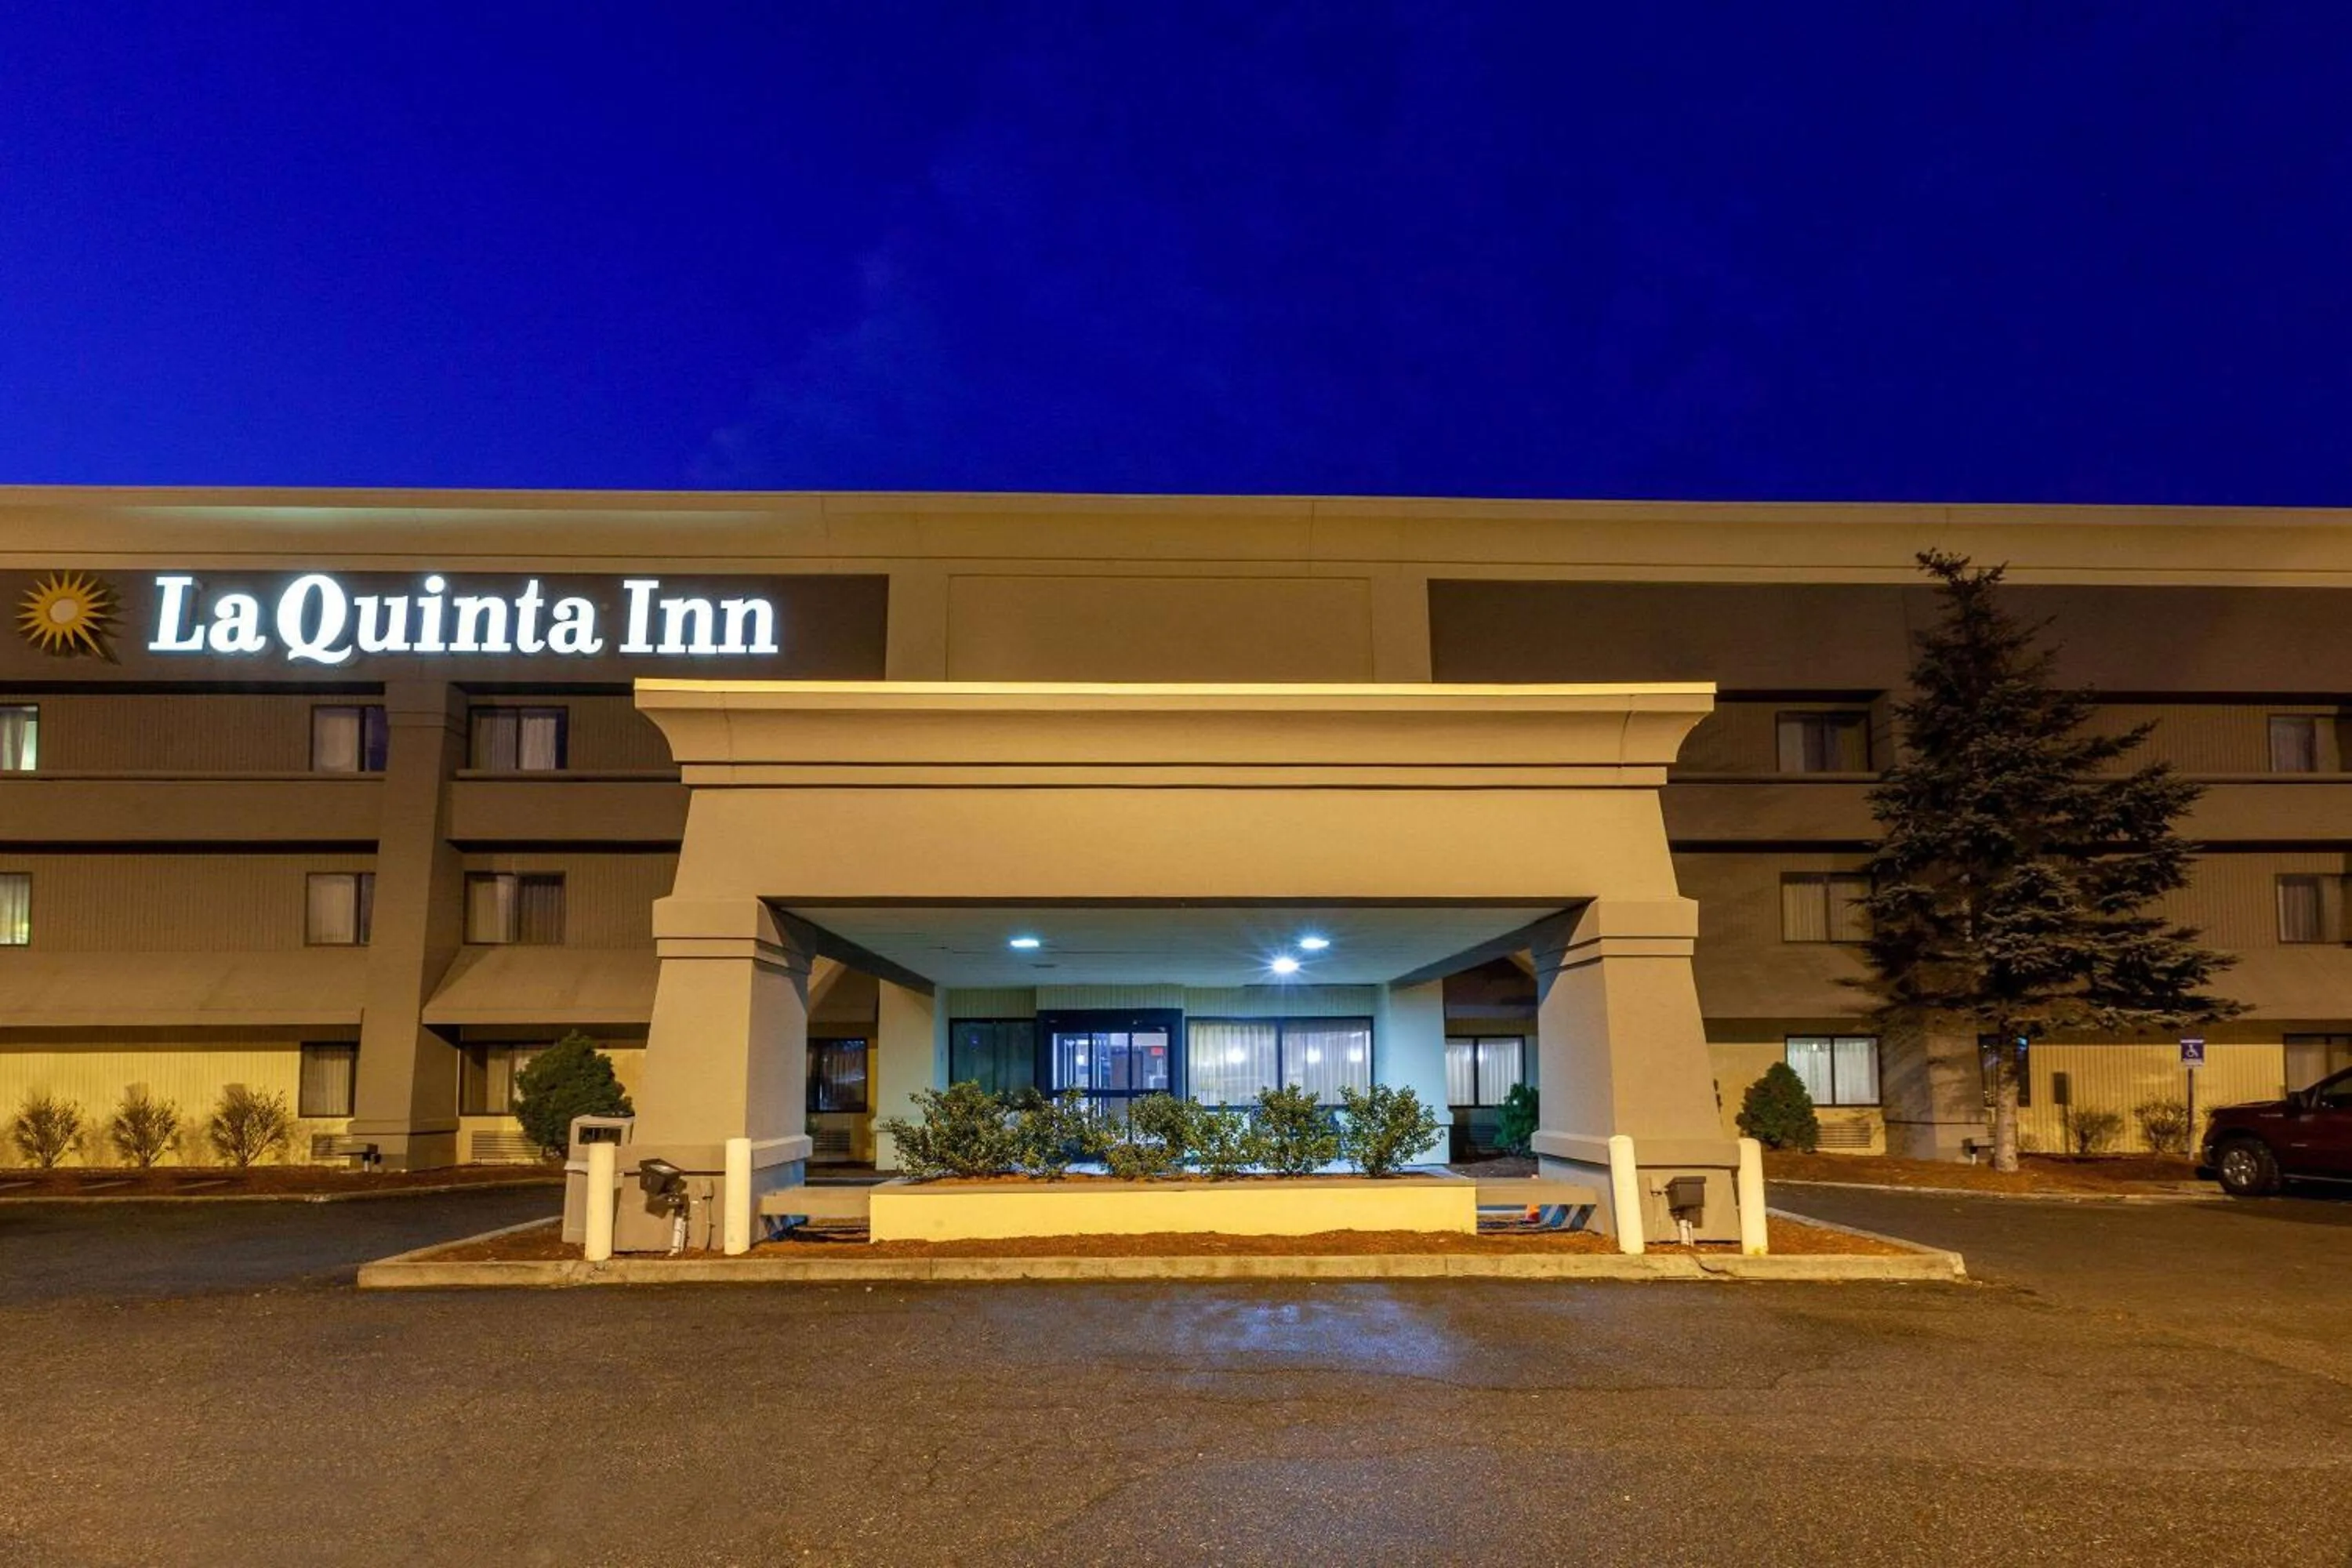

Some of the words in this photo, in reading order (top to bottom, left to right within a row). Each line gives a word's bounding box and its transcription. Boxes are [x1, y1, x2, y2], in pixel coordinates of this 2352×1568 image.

[148, 576, 267, 652] La
[277, 574, 603, 664] Quinta
[619, 579, 779, 654] Inn
